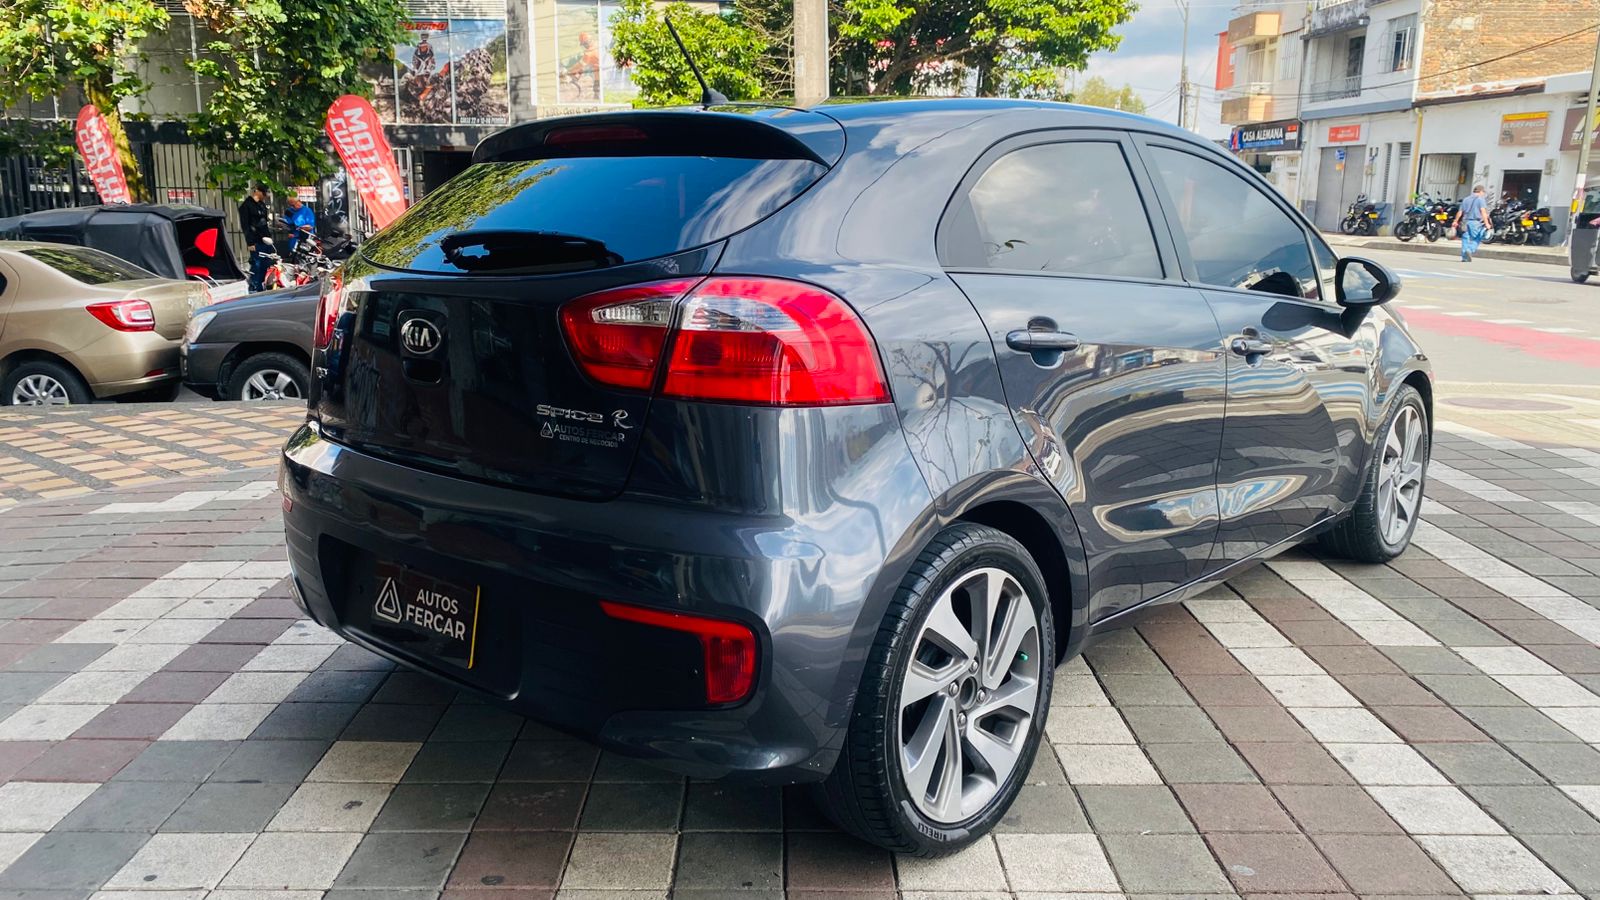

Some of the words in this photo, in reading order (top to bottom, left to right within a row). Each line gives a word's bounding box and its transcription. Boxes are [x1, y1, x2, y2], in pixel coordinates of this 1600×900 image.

[1242, 131, 1256, 142] CASA
[1256, 127, 1283, 140] ALEMANA
[79, 129, 112, 203] CUATRO
[329, 117, 373, 194] CUATRO
[343, 107, 401, 205] MOTOR
[404, 325, 433, 349] KIA
[553, 423, 585, 437] AUTOS
[586, 427, 626, 442] FERCAR
[559, 433, 581, 443] CENTRO
[416, 588, 459, 615] AUTOS
[405, 603, 466, 641] FERCAR
